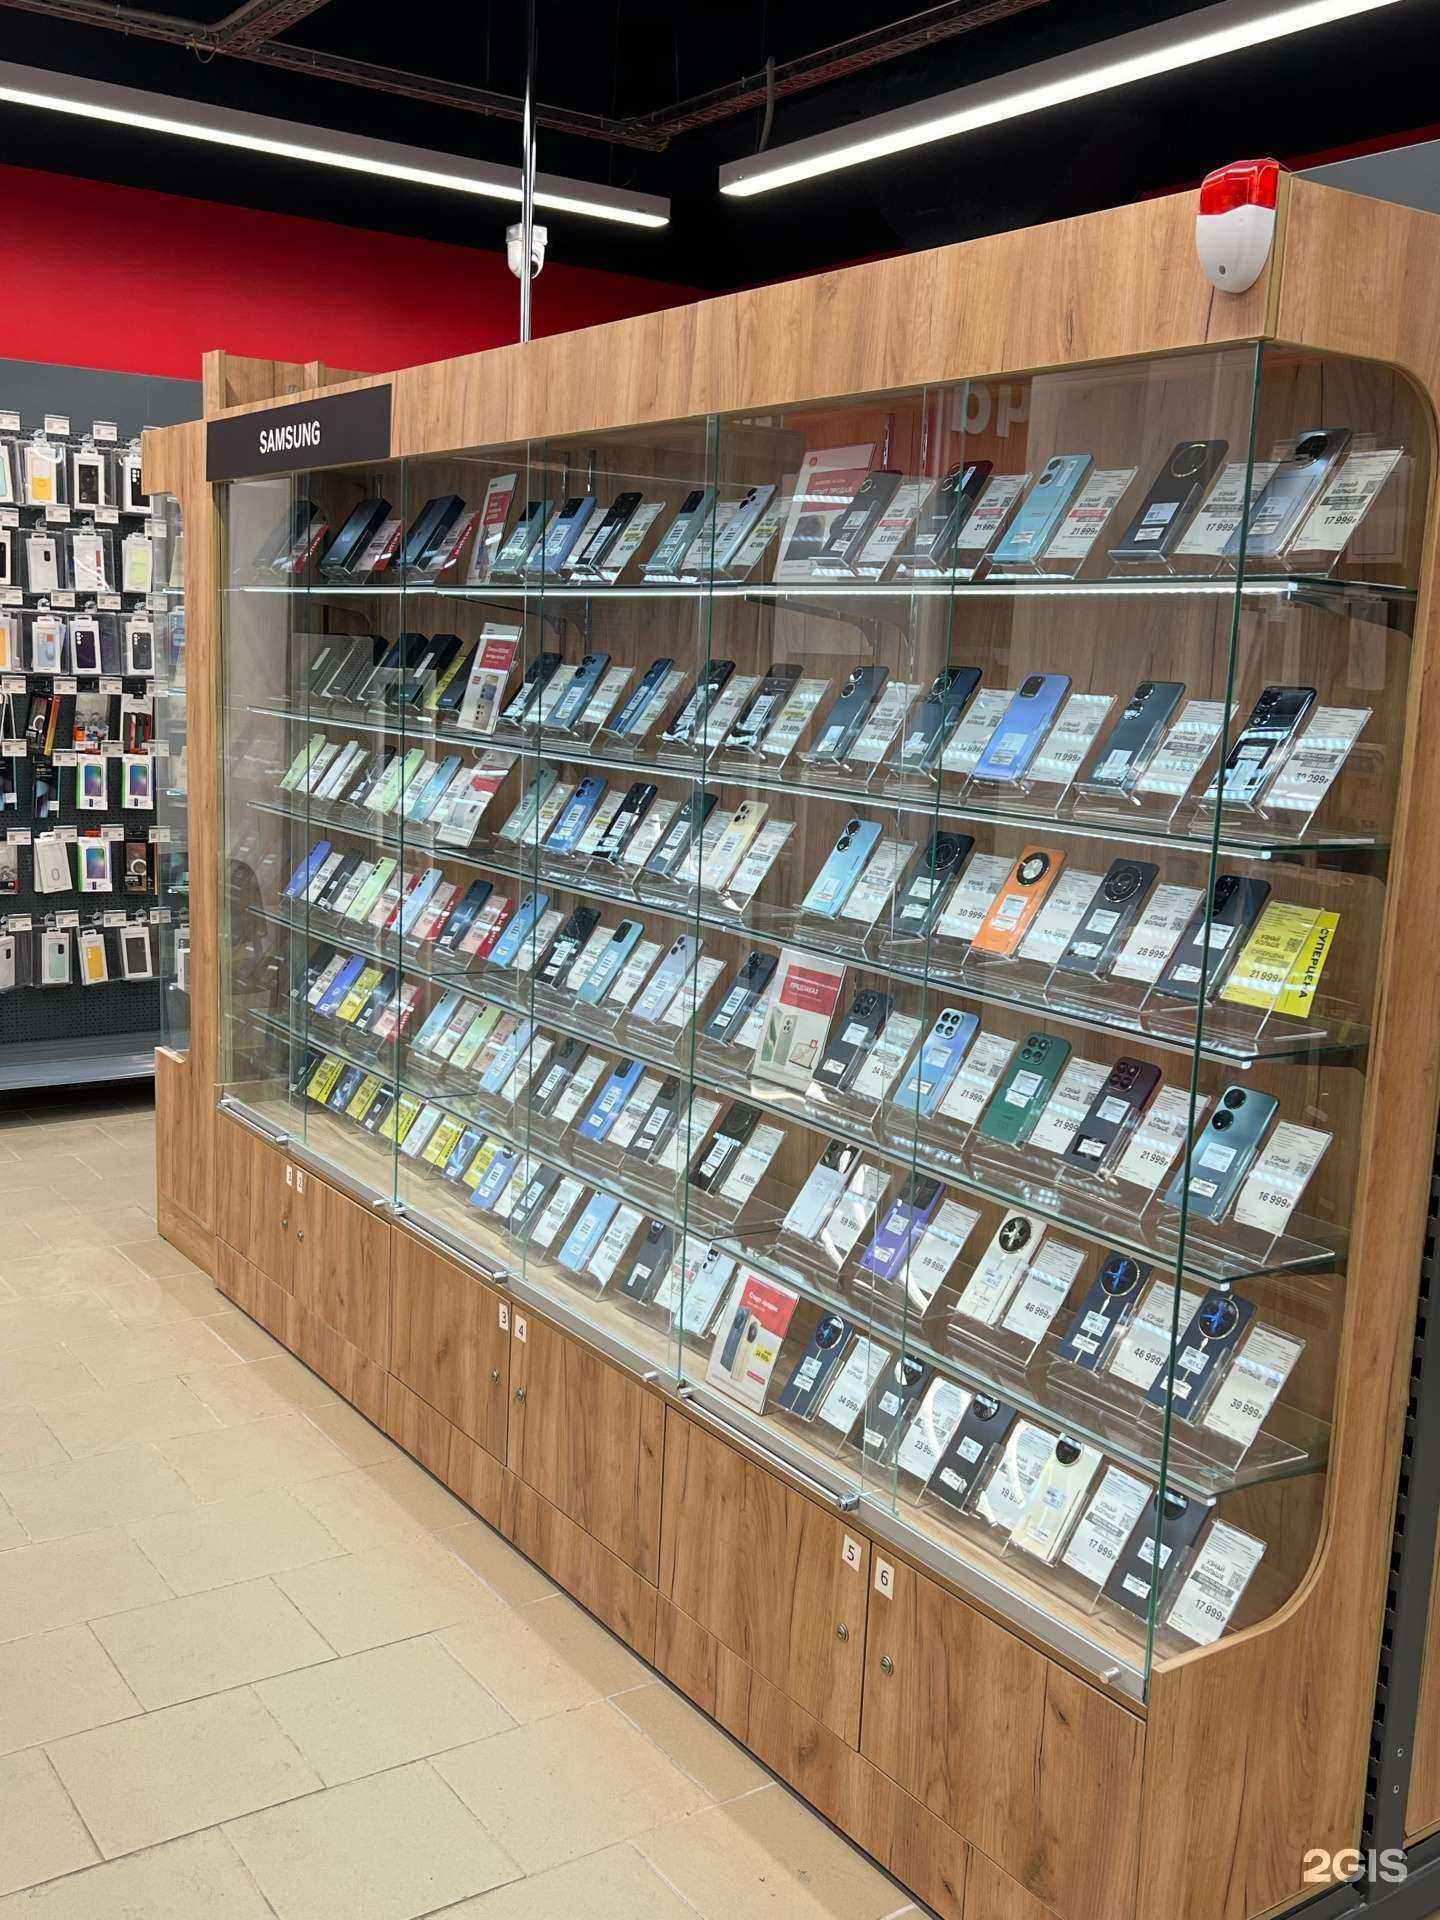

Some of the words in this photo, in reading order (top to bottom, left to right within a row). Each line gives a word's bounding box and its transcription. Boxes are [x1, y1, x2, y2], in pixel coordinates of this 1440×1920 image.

[259, 420, 321, 454] SAMSUNG
[502, 1311, 507, 1324] 3
[518, 1324, 524, 1337] 4
[847, 1544, 855, 1561] 5
[880, 1570, 889, 1586] 6
